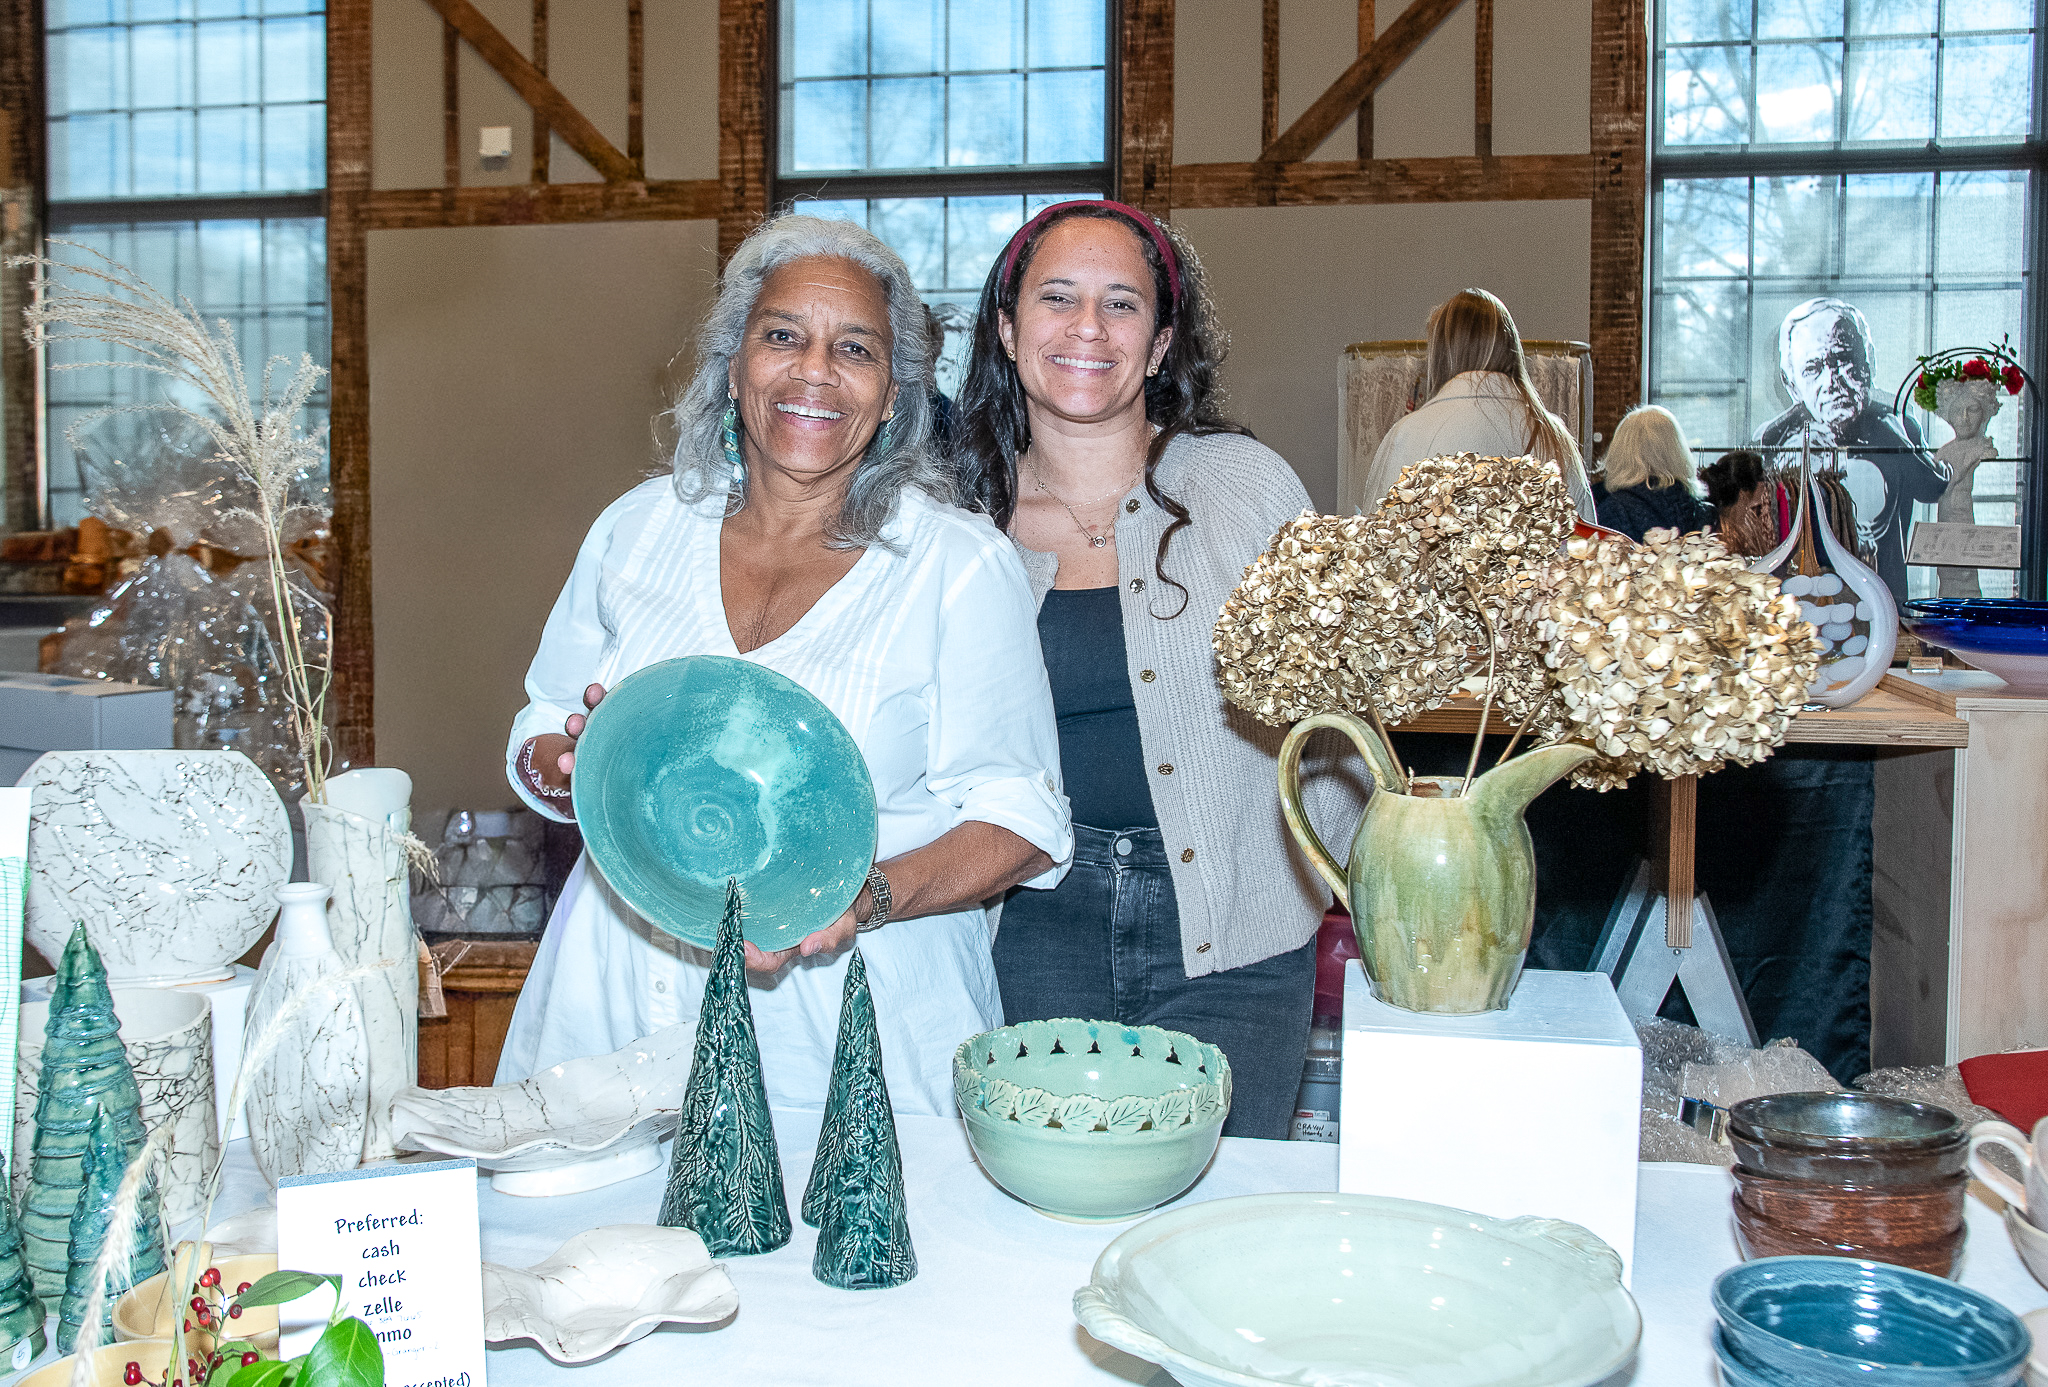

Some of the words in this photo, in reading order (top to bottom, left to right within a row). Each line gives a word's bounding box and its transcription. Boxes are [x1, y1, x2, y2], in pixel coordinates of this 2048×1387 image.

[334, 1208, 423, 1234] Preferred:
[362, 1239, 400, 1259] cash
[358, 1269, 407, 1288] check
[363, 1296, 403, 1316] zelle
